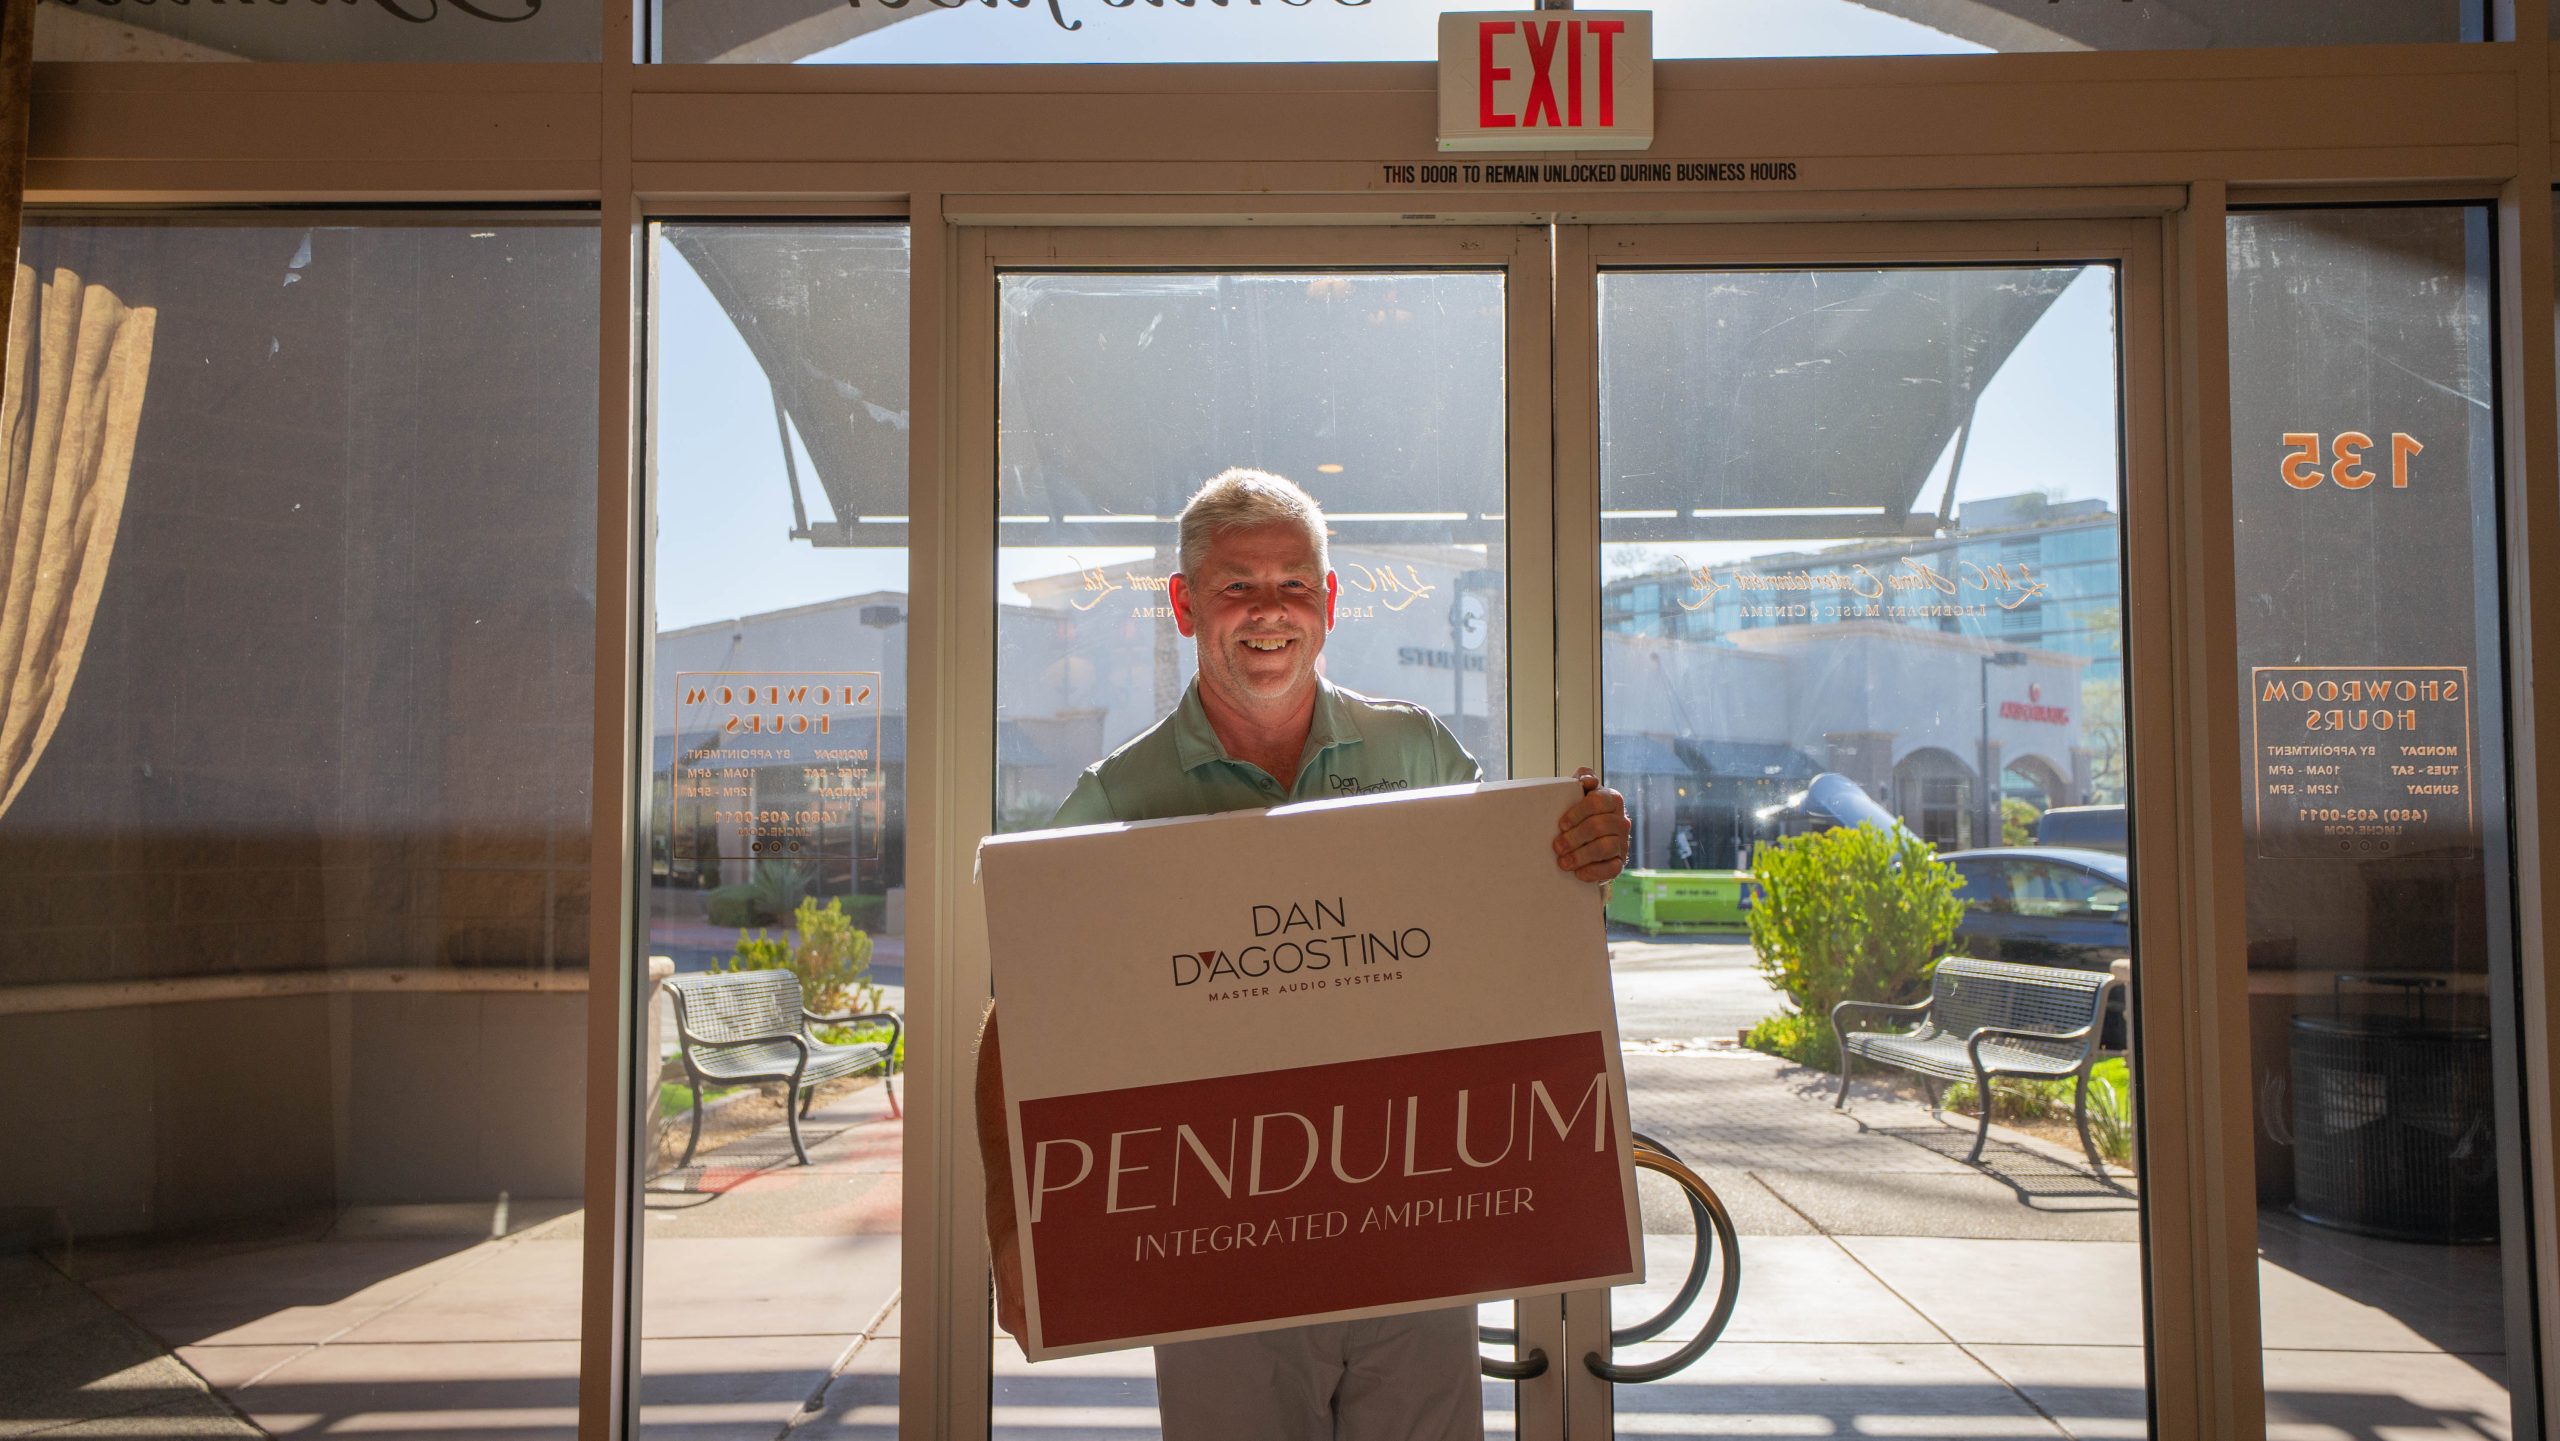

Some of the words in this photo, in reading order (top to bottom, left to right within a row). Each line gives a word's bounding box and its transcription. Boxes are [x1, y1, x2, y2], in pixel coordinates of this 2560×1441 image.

[1479, 20, 1625, 128] EXIT
[1383, 165, 1415, 184] THIS
[1420, 165, 1457, 184] DOOR
[1462, 165, 1481, 183] TO
[1485, 164, 1539, 183] REMAIN
[1543, 164, 1616, 183] UNLOCKED
[1620, 163, 1671, 183] DURING
[1676, 162, 1745, 182] BUSINESS
[1750, 161, 1797, 181] HOURS
[1329, 774, 1359, 789] Dan
[1252, 897, 1346, 937] DAN
[1208, 987, 1270, 1002] MASTER
[1279, 980, 1326, 994] AUDIO
[1335, 971, 1404, 987] SYSTEMS
[1029, 1071, 1607, 1224] PENDULUM
[1135, 1210, 1349, 1262] INTEGRATED
[1360, 1186, 1535, 1234] AMPLIFIER
